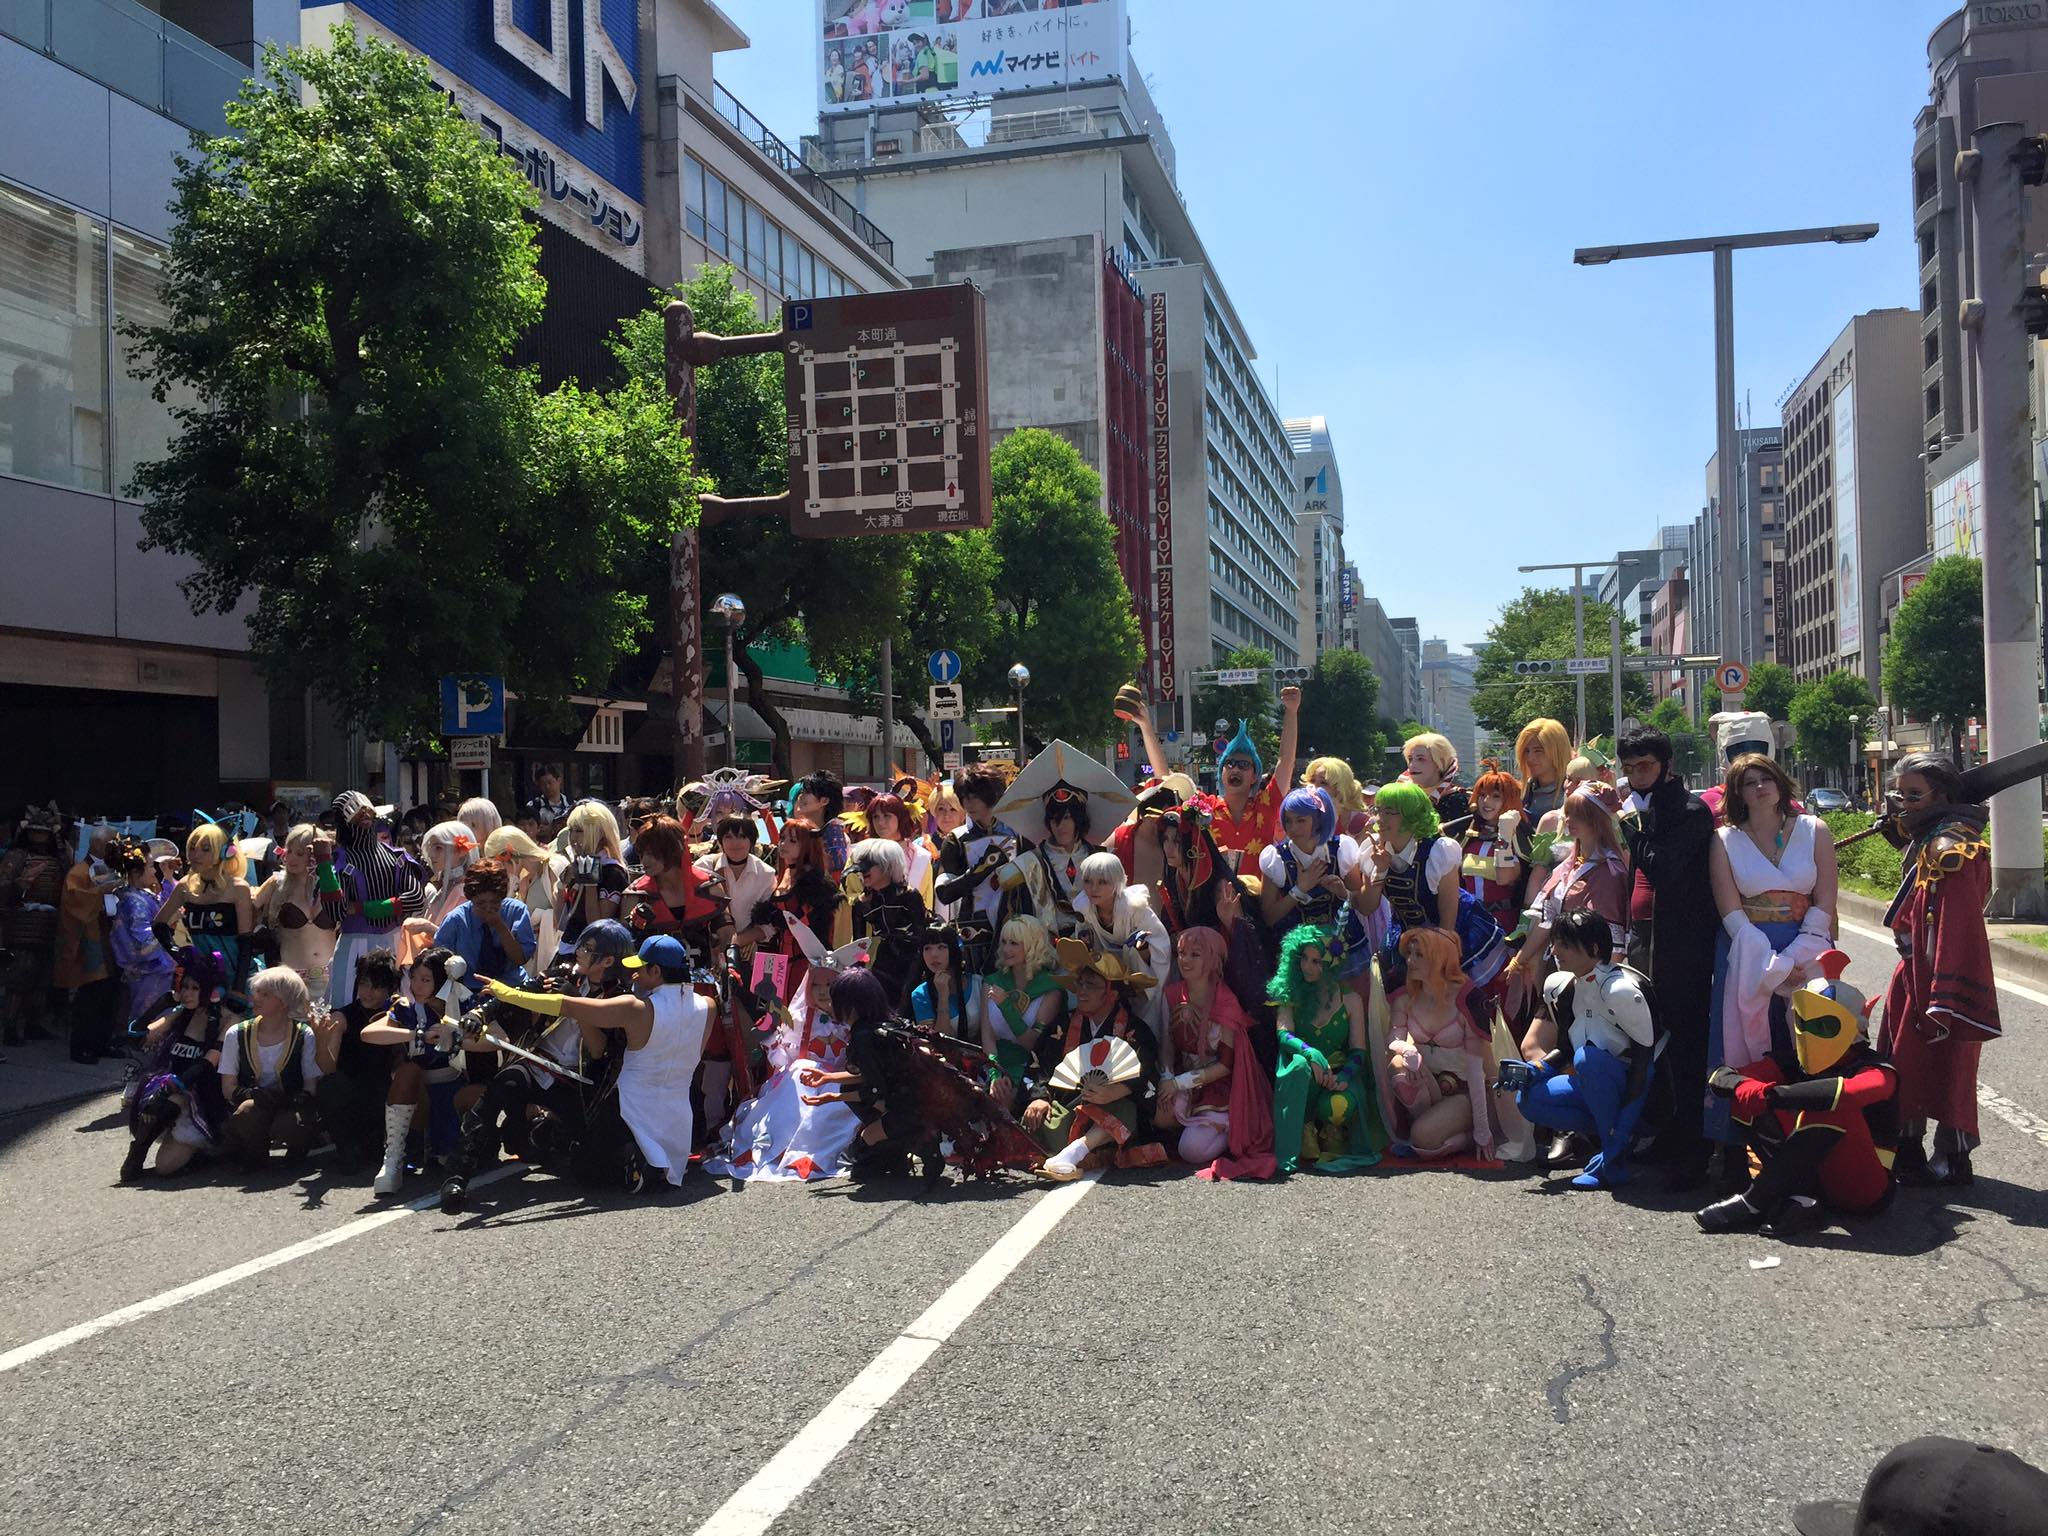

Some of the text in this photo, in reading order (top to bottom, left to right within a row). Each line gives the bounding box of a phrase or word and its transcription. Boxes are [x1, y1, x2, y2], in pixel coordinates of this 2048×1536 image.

[1005, 50, 1060, 73] マイナビ
[794, 306, 809, 330] P
[857, 327, 897, 343] 本町通
[896, 492, 912, 508] 栄
[1304, 500, 1328, 511] ARK
[864, 514, 904, 529] 大津通
[936, 510, 969, 522] 現在地
[457, 680, 492, 729] P
[943, 723, 952, 751] P
